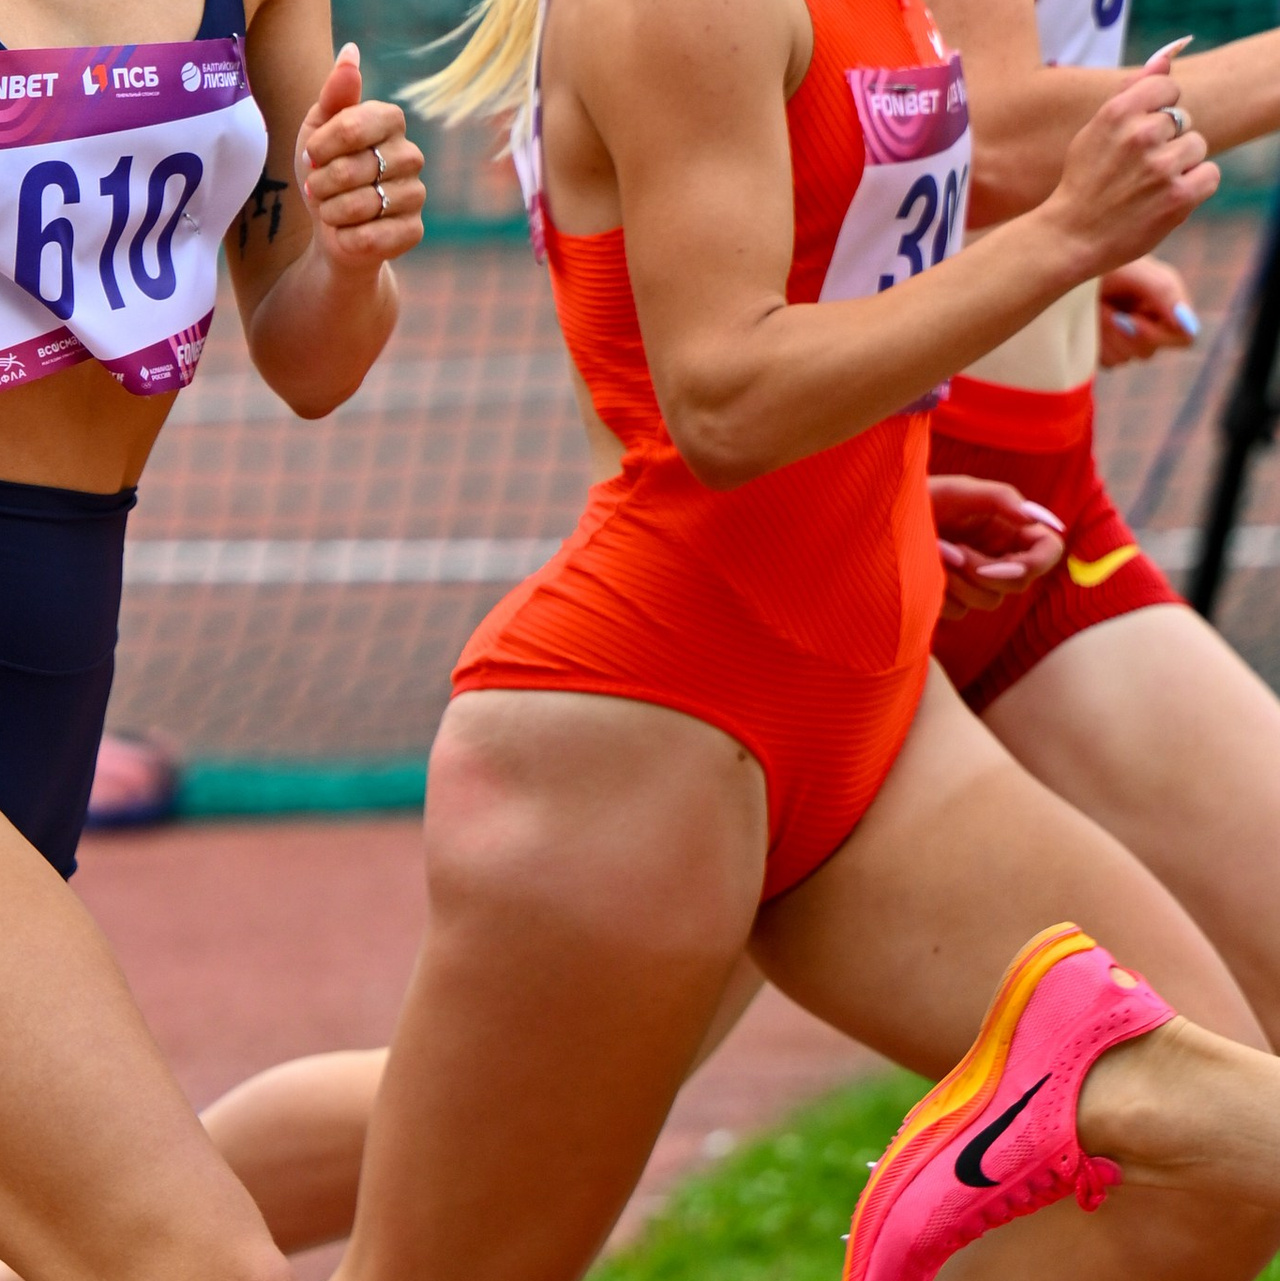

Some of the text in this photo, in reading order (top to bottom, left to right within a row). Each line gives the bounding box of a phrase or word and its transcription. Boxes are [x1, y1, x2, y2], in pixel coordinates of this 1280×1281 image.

[113, 66, 159, 89] ПСБ
[871, 89, 940, 116] FONBET
[15, 152, 203, 321] 610
